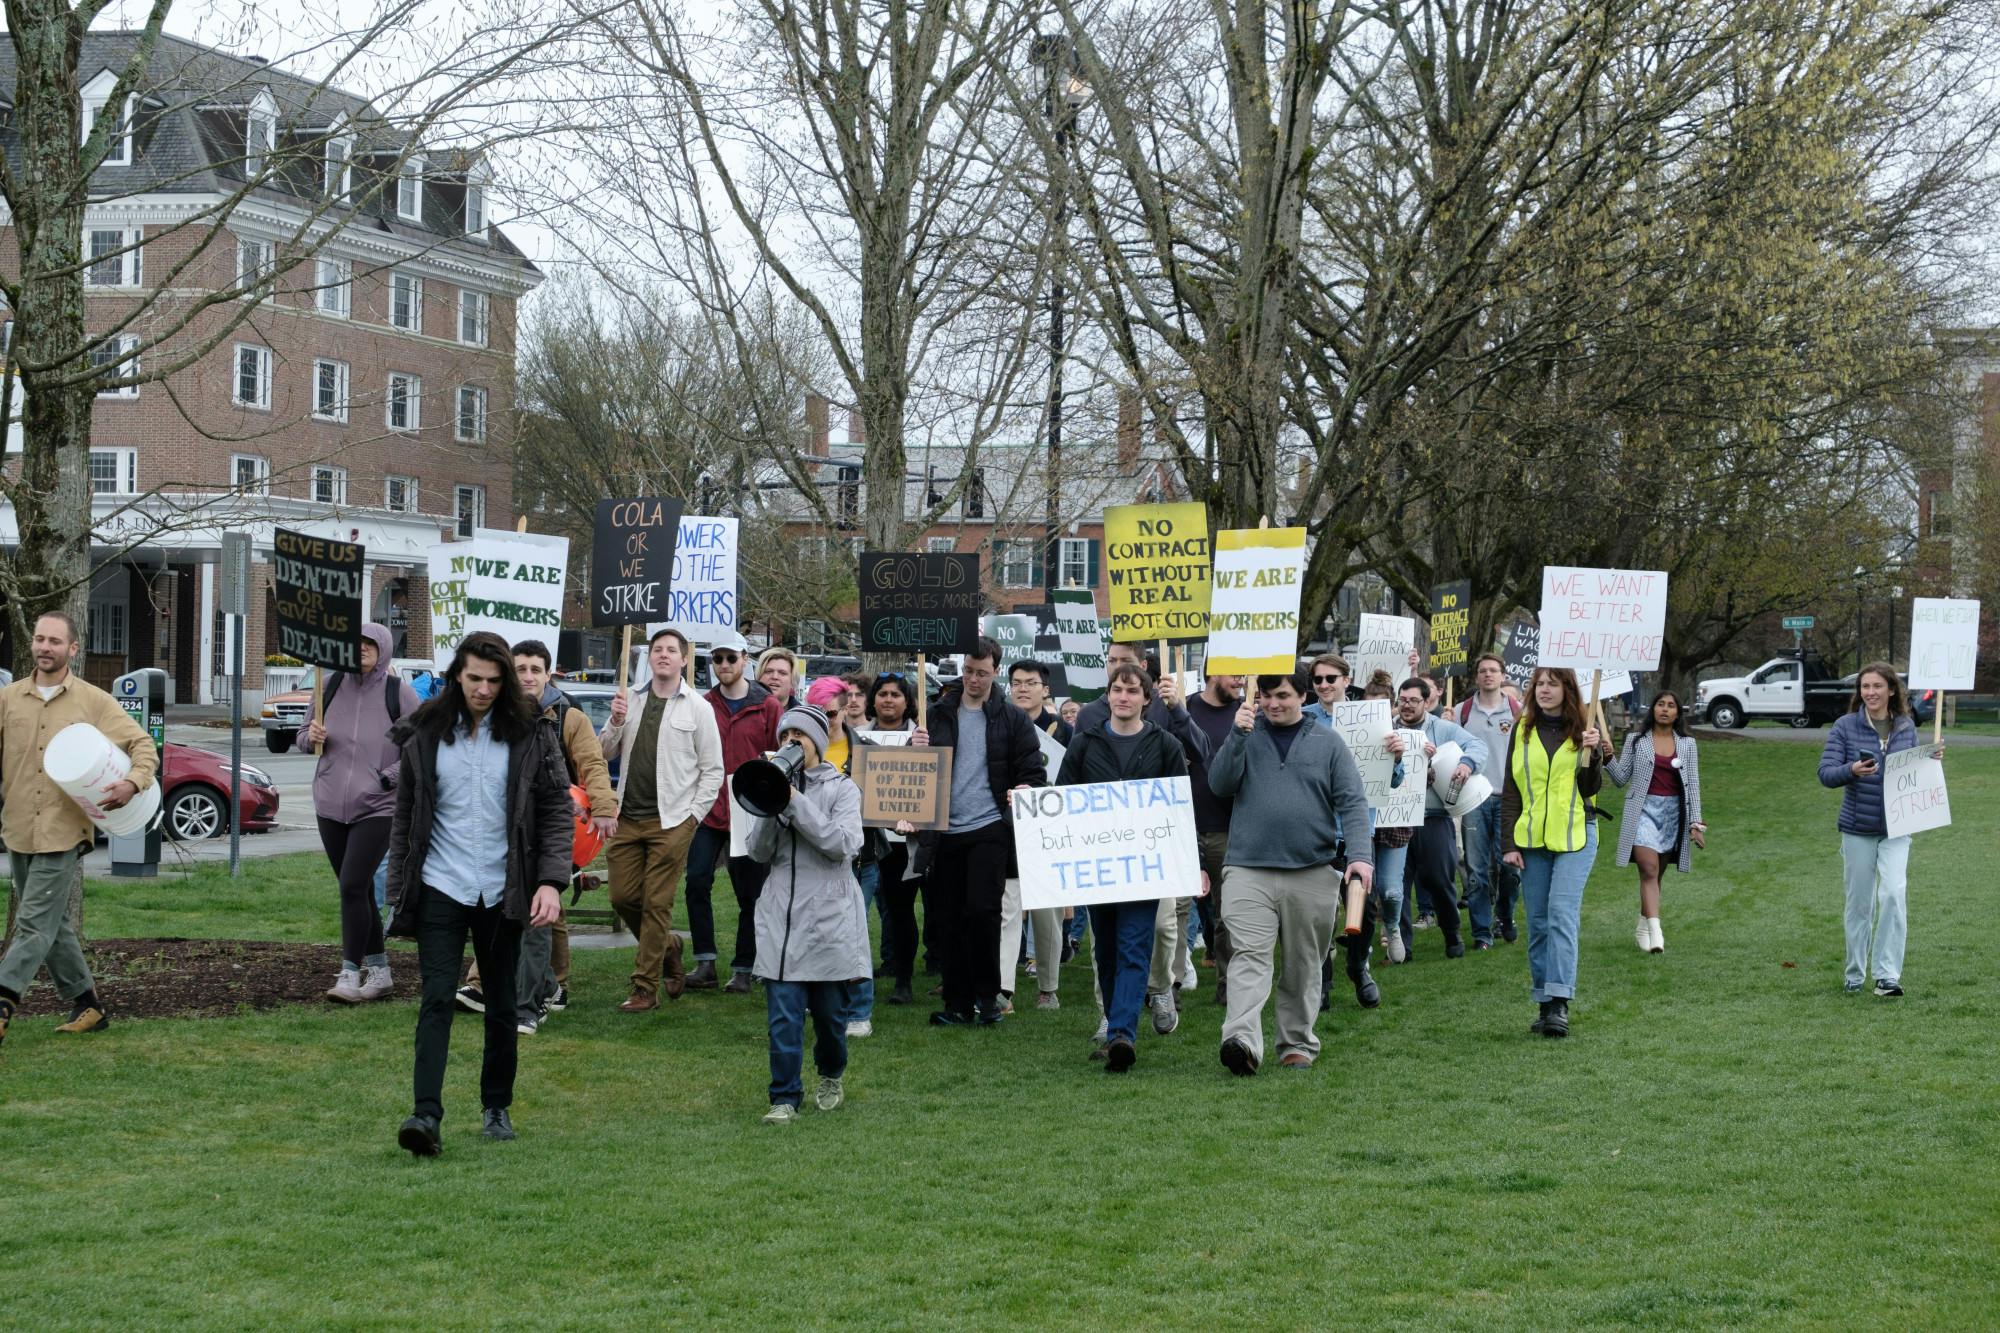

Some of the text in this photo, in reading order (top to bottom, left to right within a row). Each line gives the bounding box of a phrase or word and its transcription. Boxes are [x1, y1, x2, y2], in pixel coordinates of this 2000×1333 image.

[612, 502, 663, 527] COLA
[675, 523, 725, 549] OWER
[1137, 519, 1173, 537] NO
[276, 533, 357, 562] GIVE US
[627, 531, 648, 555] OR
[1108, 538, 1208, 560] CONTRACT
[275, 555, 363, 600] DENTAL
[475, 558, 561, 585] WE ARE
[620, 558, 645, 578] WE
[688, 554, 726, 581] THE
[872, 556, 965, 588] GOLD
[1109, 564, 1209, 586] WITHOUT
[1215, 567, 1297, 589] WE ARE
[431, 580, 468, 598] CONT
[1129, 585, 1192, 605] REAL
[1550, 573, 1656, 597] WE WANT
[297, 588, 325, 611] OR
[601, 582, 660, 614] STRIKE
[668, 590, 733, 626] ORKERS
[865, 592, 977, 610] DESERVES MORE
[1442, 594, 1457, 609] NO
[277, 600, 349, 633] GIVE US
[466, 597, 560, 627] WORKERS
[1112, 609, 1210, 631] PROTECTION
[1210, 611, 1298, 633] WORKERS
[1431, 608, 1469, 626] CONTRACT
[1569, 602, 1643, 623] BETTER
[872, 617, 958, 646] GREEN
[997, 626, 1016, 640] NO
[1059, 618, 1075, 634] WE
[1076, 619, 1096, 634] ARE
[1366, 617, 1404, 638] FAIR
[1431, 622, 1469, 641] WITHOUT
[282, 625, 356, 668] DEATH
[1001, 644, 1033, 659] TRACT
[1359, 639, 1410, 656] CONTRAC
[1437, 636, 1460, 652] REAL
[1547, 630, 1663, 662] HEALTHCARE
[1062, 652, 1105, 668] WORKERS
[1431, 650, 1468, 668] PROTECTION
[1522, 653, 1538, 665] OR
[125, 681, 134, 693] P
[120, 701, 142, 710] 7524
[1335, 701, 1386, 727] RIGHT
[150, 716, 163, 725] 7524
[1346, 729, 1368, 744] TO
[868, 760, 937, 773] WORKERS
[876, 775, 927, 786] OF THE
[1897, 770, 1917, 792] ON
[876, 788, 926, 799] WORLD
[879, 801, 921, 813] UNITE
[1376, 804, 1418, 824] NOW
[1889, 786, 1946, 824] STRIKE
[1040, 818, 1176, 851] but we've got
[1051, 853, 1164, 890] TEETH
